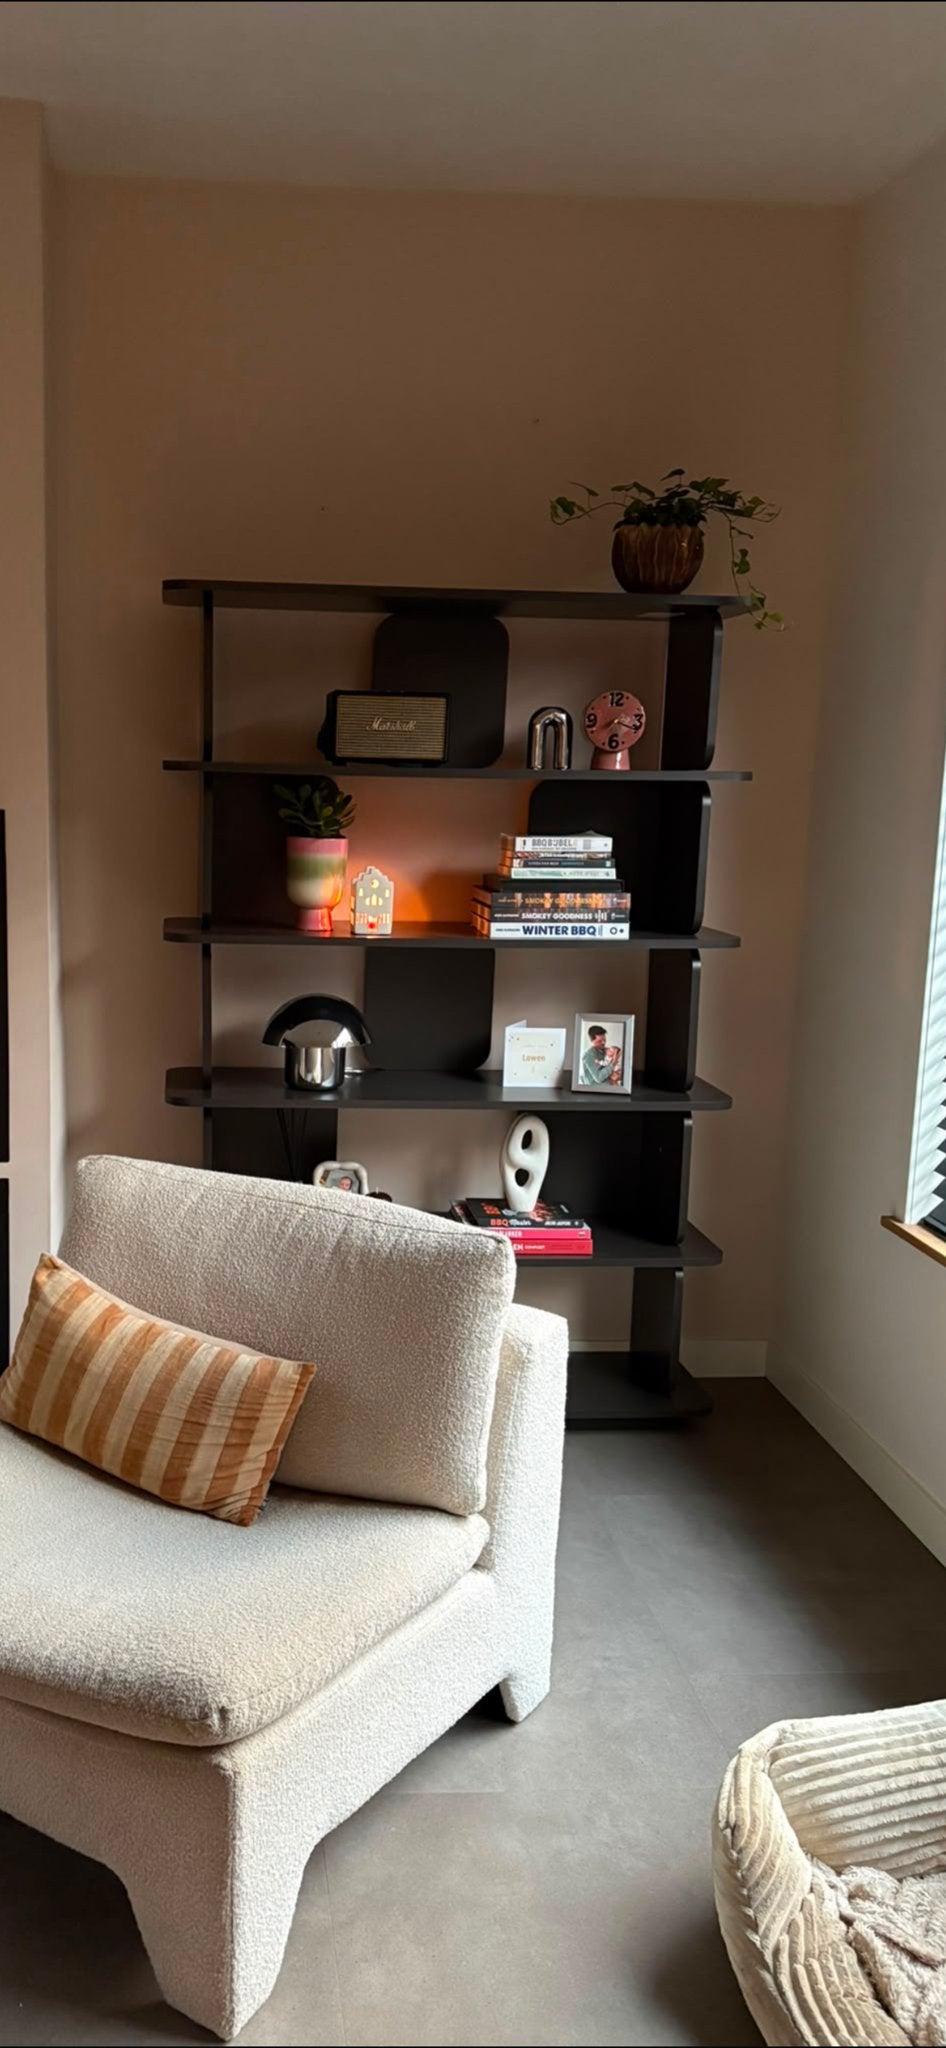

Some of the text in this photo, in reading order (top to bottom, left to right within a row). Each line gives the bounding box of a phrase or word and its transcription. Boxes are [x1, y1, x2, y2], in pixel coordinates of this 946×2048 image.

[609, 692, 624, 707] 12
[365, 717, 417, 731] Marshall
[587, 713, 597, 728] 9
[633, 713, 643, 731] 3
[608, 733, 619, 749] 6
[522, 926, 596, 936] WINTER BBQ
[490, 1219, 508, 1227] BBQ
